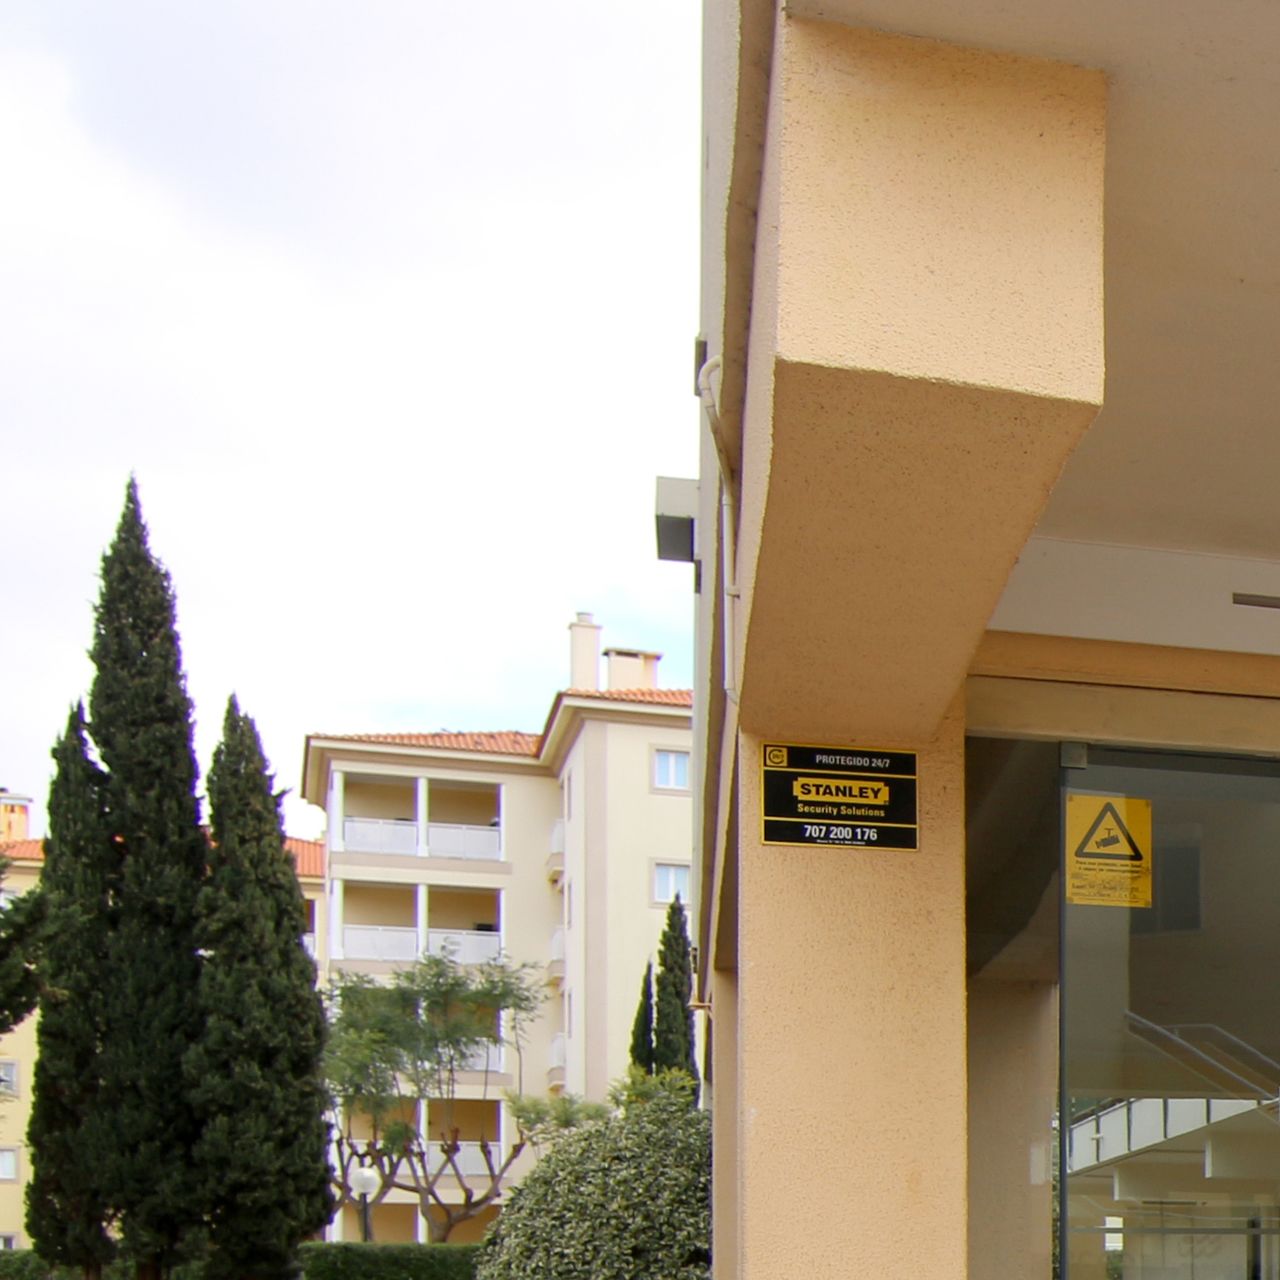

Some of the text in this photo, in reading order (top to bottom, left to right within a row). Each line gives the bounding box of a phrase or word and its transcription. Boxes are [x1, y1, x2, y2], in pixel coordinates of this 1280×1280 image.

[815, 754, 891, 768] PROTEGIDO 24/7
[800, 783, 882, 799] STANLEY
[797, 803, 885, 817] Security Solutions
[804, 825, 878, 841] 707 200 176
